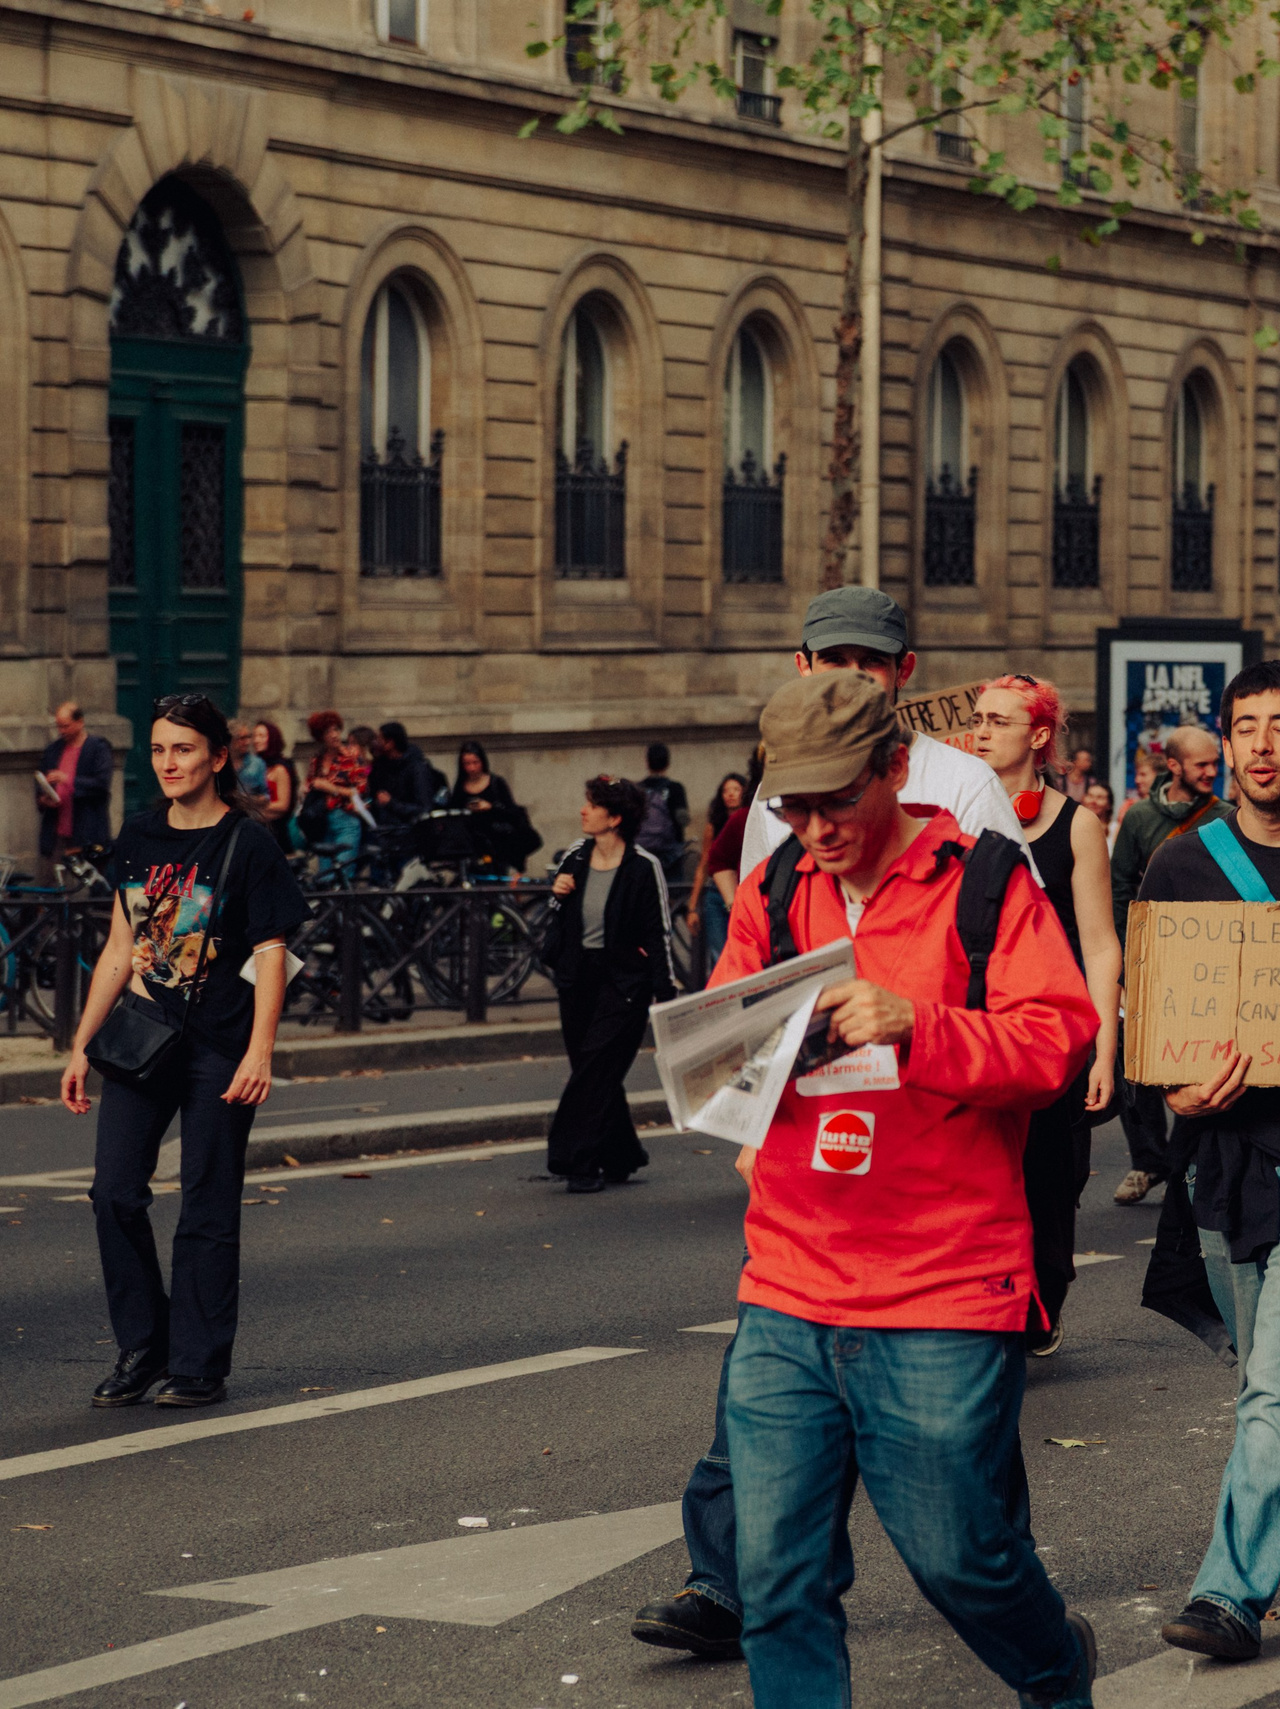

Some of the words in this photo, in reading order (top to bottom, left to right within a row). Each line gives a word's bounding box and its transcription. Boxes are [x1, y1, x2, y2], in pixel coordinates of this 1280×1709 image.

[1145, 664, 1169, 690] LA
[938, 694, 967, 731] DE
[1193, 963, 1229, 984] DE
[1163, 988, 1177, 1018] À
[1191, 996, 1217, 1017] LA
[1162, 1039, 1235, 1063] NTM
